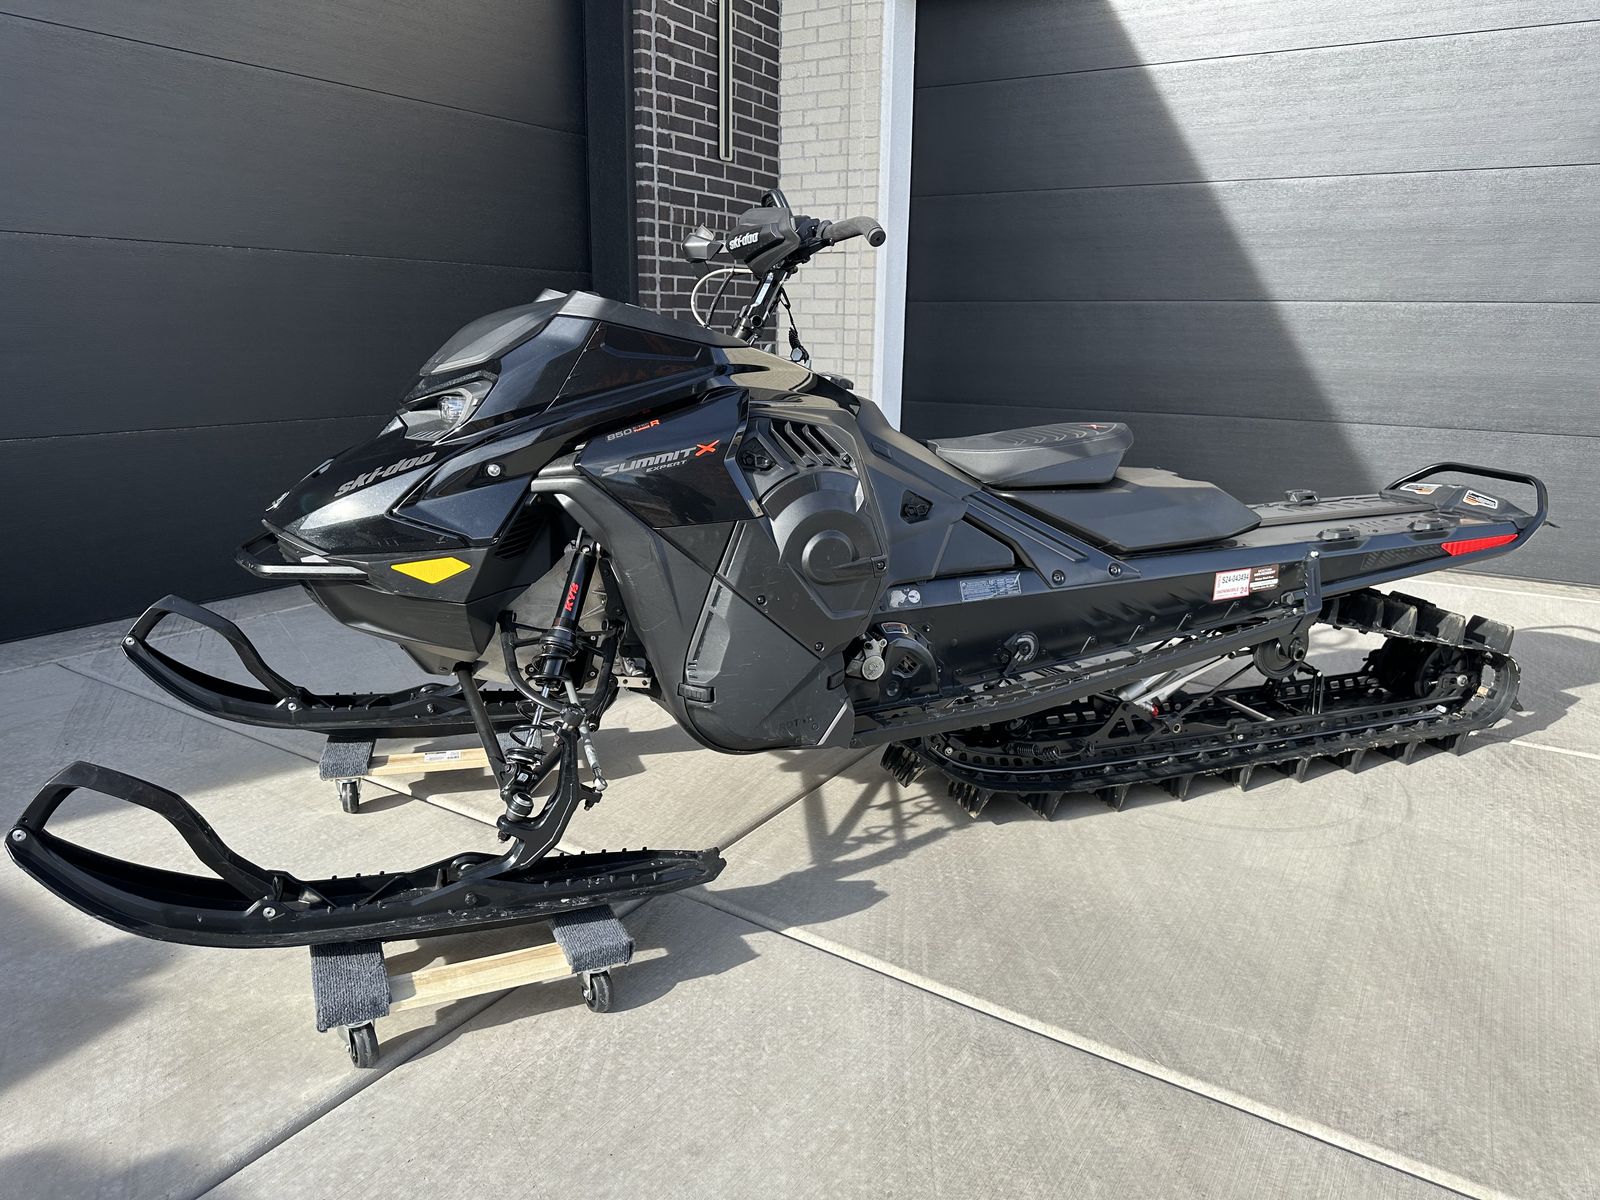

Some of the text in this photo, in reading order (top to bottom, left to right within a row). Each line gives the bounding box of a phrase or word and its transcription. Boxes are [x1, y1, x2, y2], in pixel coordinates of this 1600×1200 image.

[729, 232, 759, 250] ski-doo
[606, 427, 633, 441] 850
[601, 439, 720, 477] SUMMIT X
[645, 459, 687, 473] EXPERT
[334, 451, 437, 497] ski-doo
[565, 582, 579, 612] KYB
[1240, 586, 1248, 594] 24
